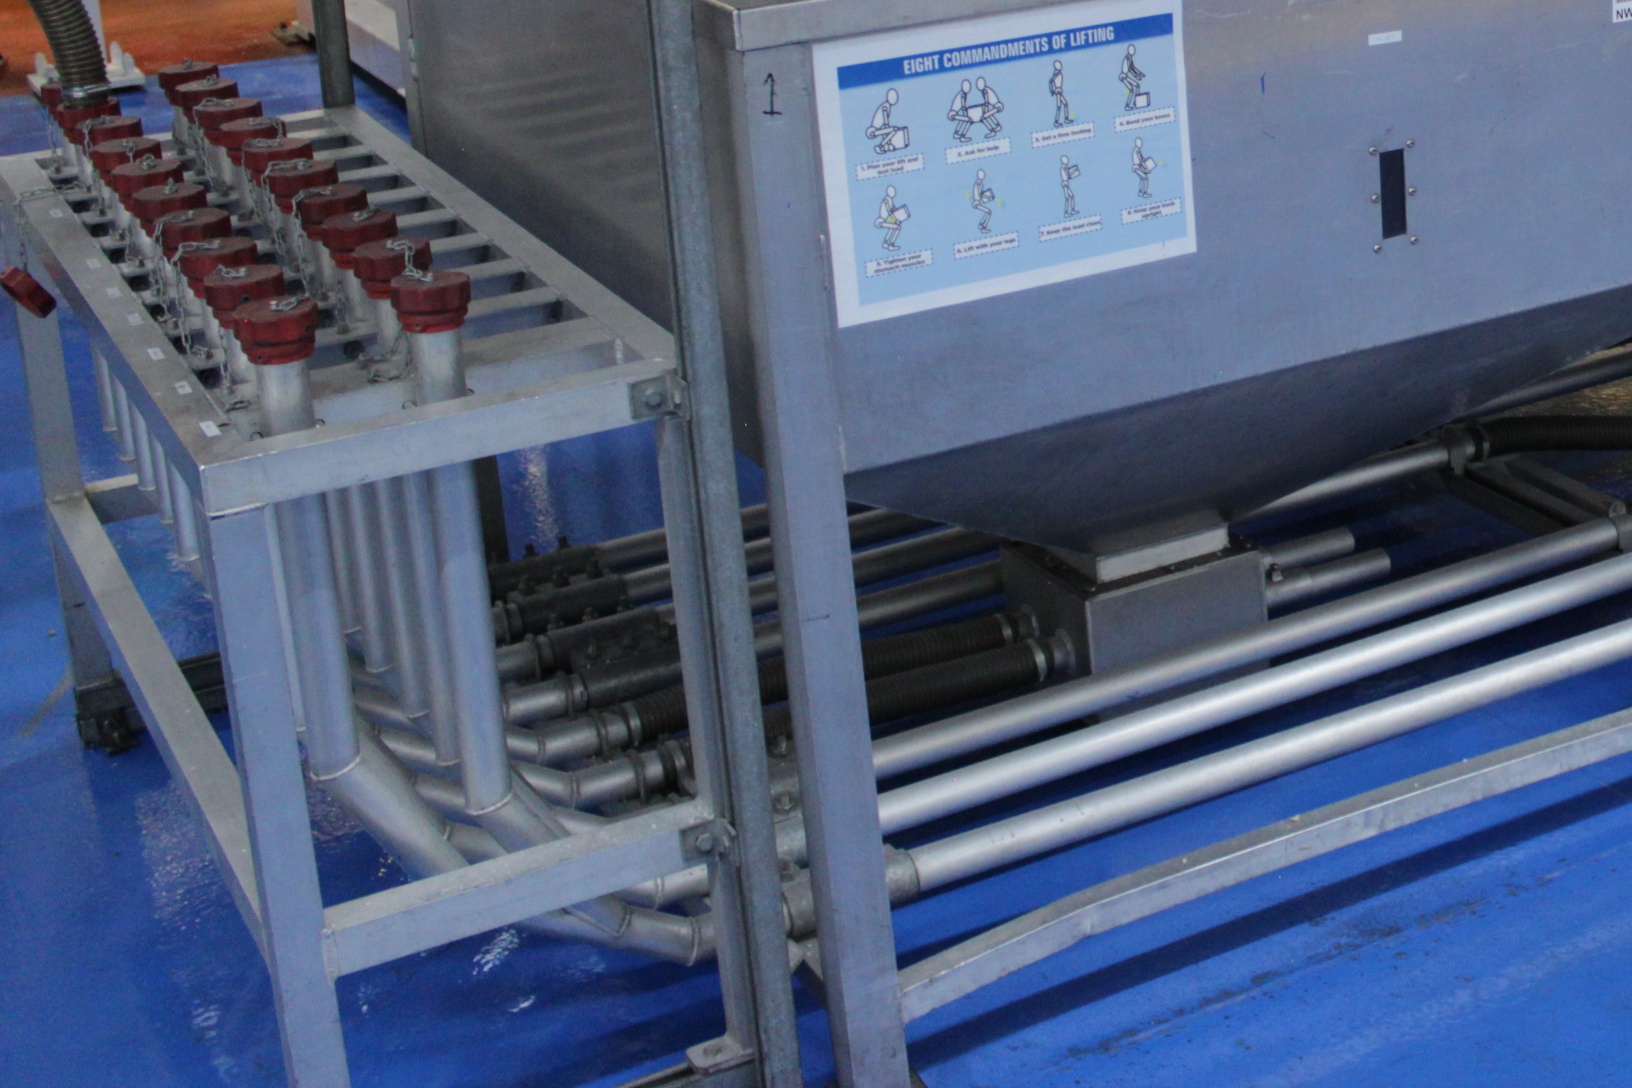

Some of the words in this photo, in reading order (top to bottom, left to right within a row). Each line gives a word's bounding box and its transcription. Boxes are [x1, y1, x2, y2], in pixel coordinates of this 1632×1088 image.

[903, 54, 940, 75] EIGHT
[943, 37, 1049, 68] COMMANDMENTS
[1052, 33, 1067, 50] OF
[1069, 26, 1115, 47] LIFTING
